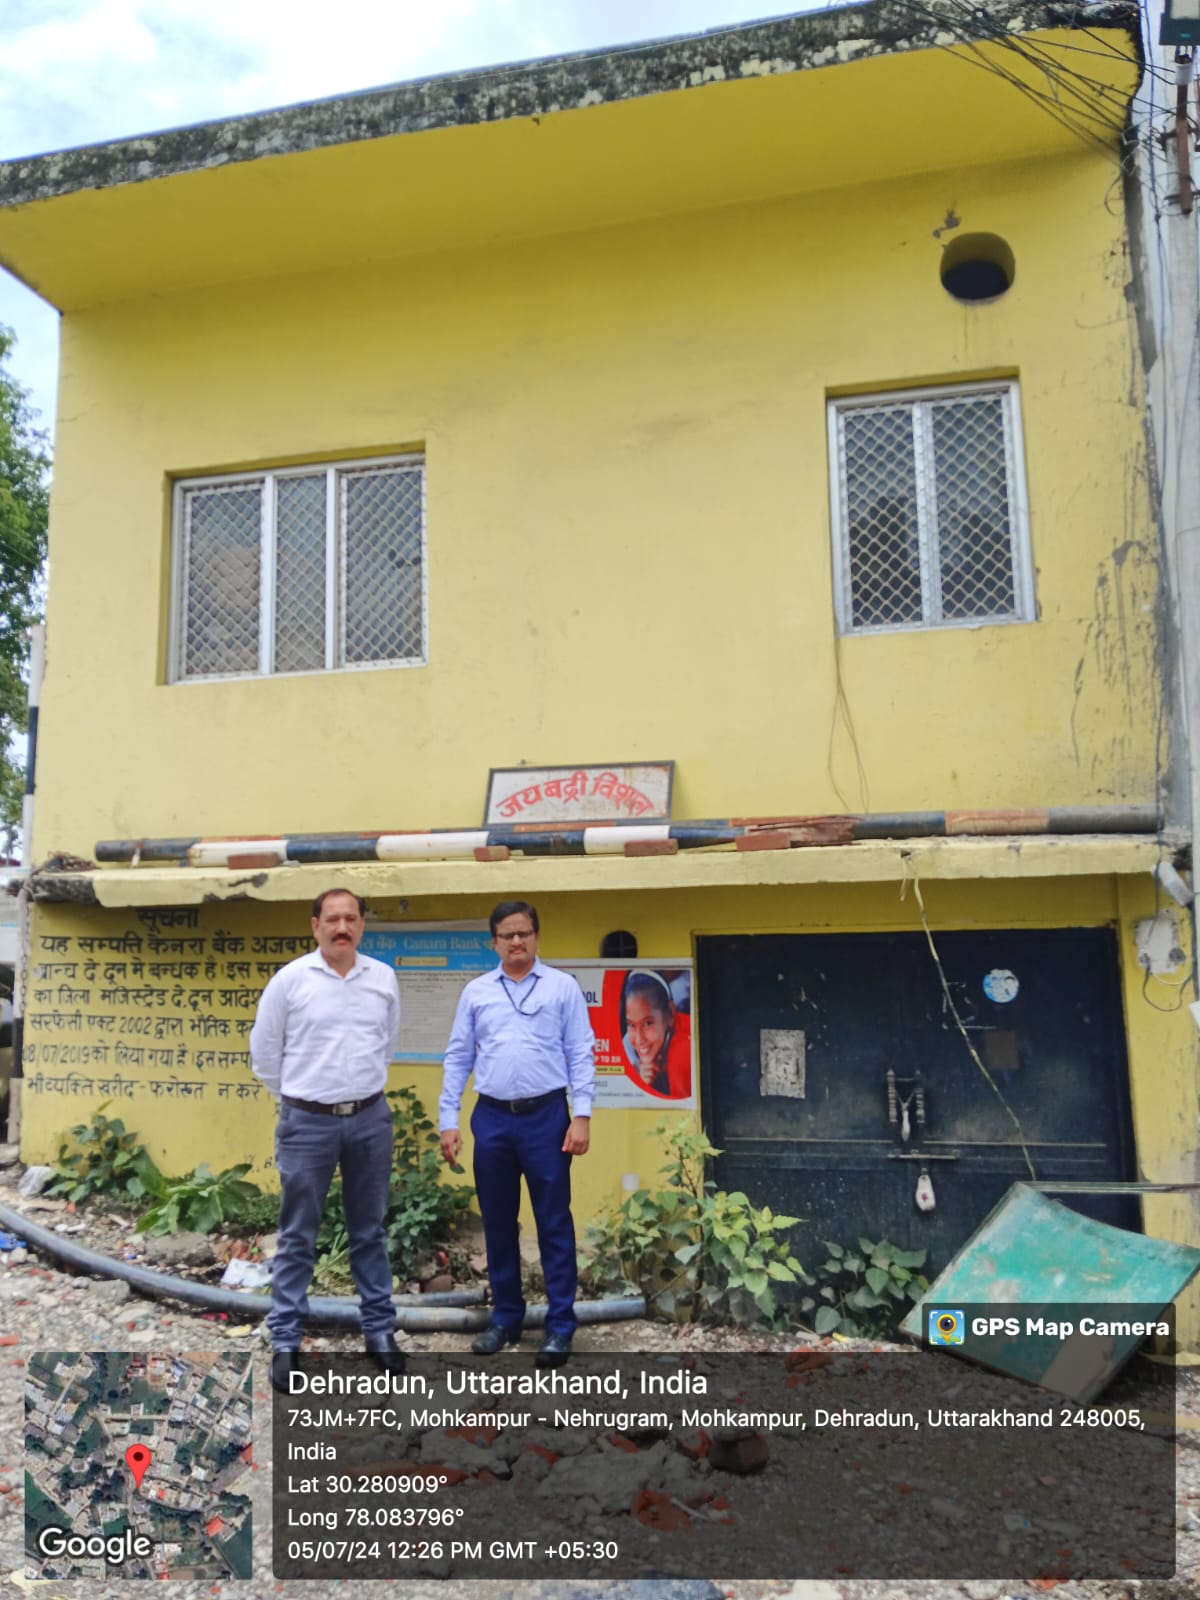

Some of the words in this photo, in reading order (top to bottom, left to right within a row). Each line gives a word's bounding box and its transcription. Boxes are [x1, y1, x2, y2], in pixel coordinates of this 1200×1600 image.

[496, 784, 543, 818] जय
[543, 770, 587, 804] बद्री
[137, 908, 199, 933] सूचना
[39, 935, 72, 955] यह
[211, 929, 245, 954] बैंक
[450, 936, 481, 950] Bank
[33, 989, 53, 1005] का
[57, 983, 91, 1005] जिला
[119, 1015, 153, 1035] 2002
